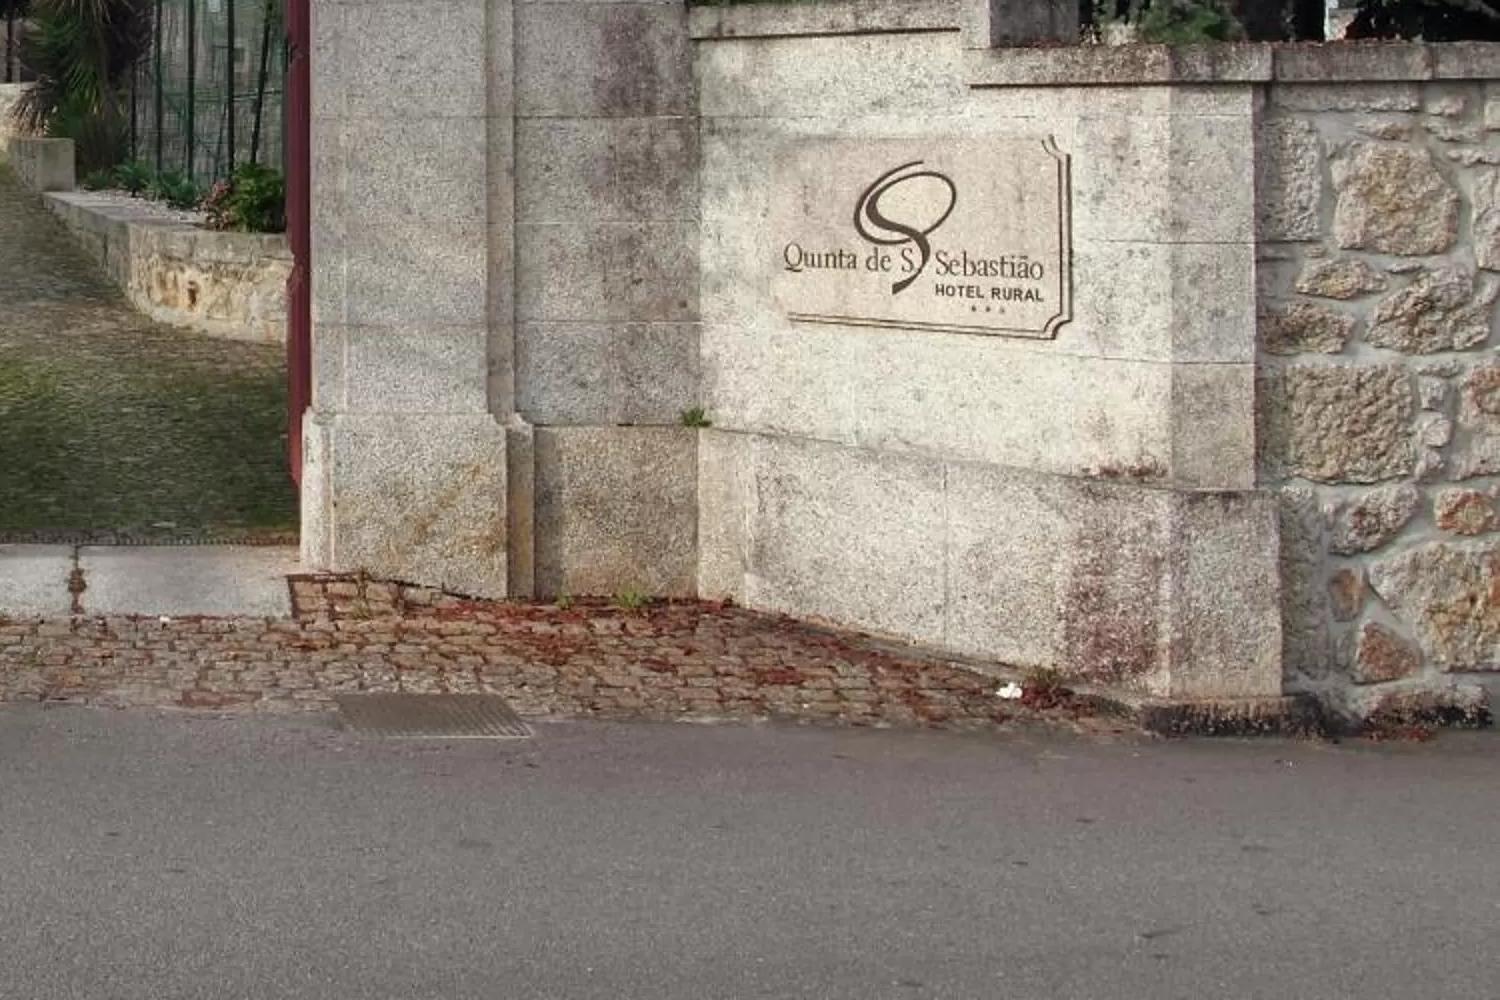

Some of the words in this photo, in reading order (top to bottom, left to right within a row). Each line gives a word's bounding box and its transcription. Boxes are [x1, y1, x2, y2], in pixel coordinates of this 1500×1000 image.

[783, 242, 858, 273] Quinta
[865, 246, 892, 272] de
[935, 249, 1044, 281] Sebastião
[935, 283, 984, 299] HOTEL
[991, 286, 1044, 303] RURAL
